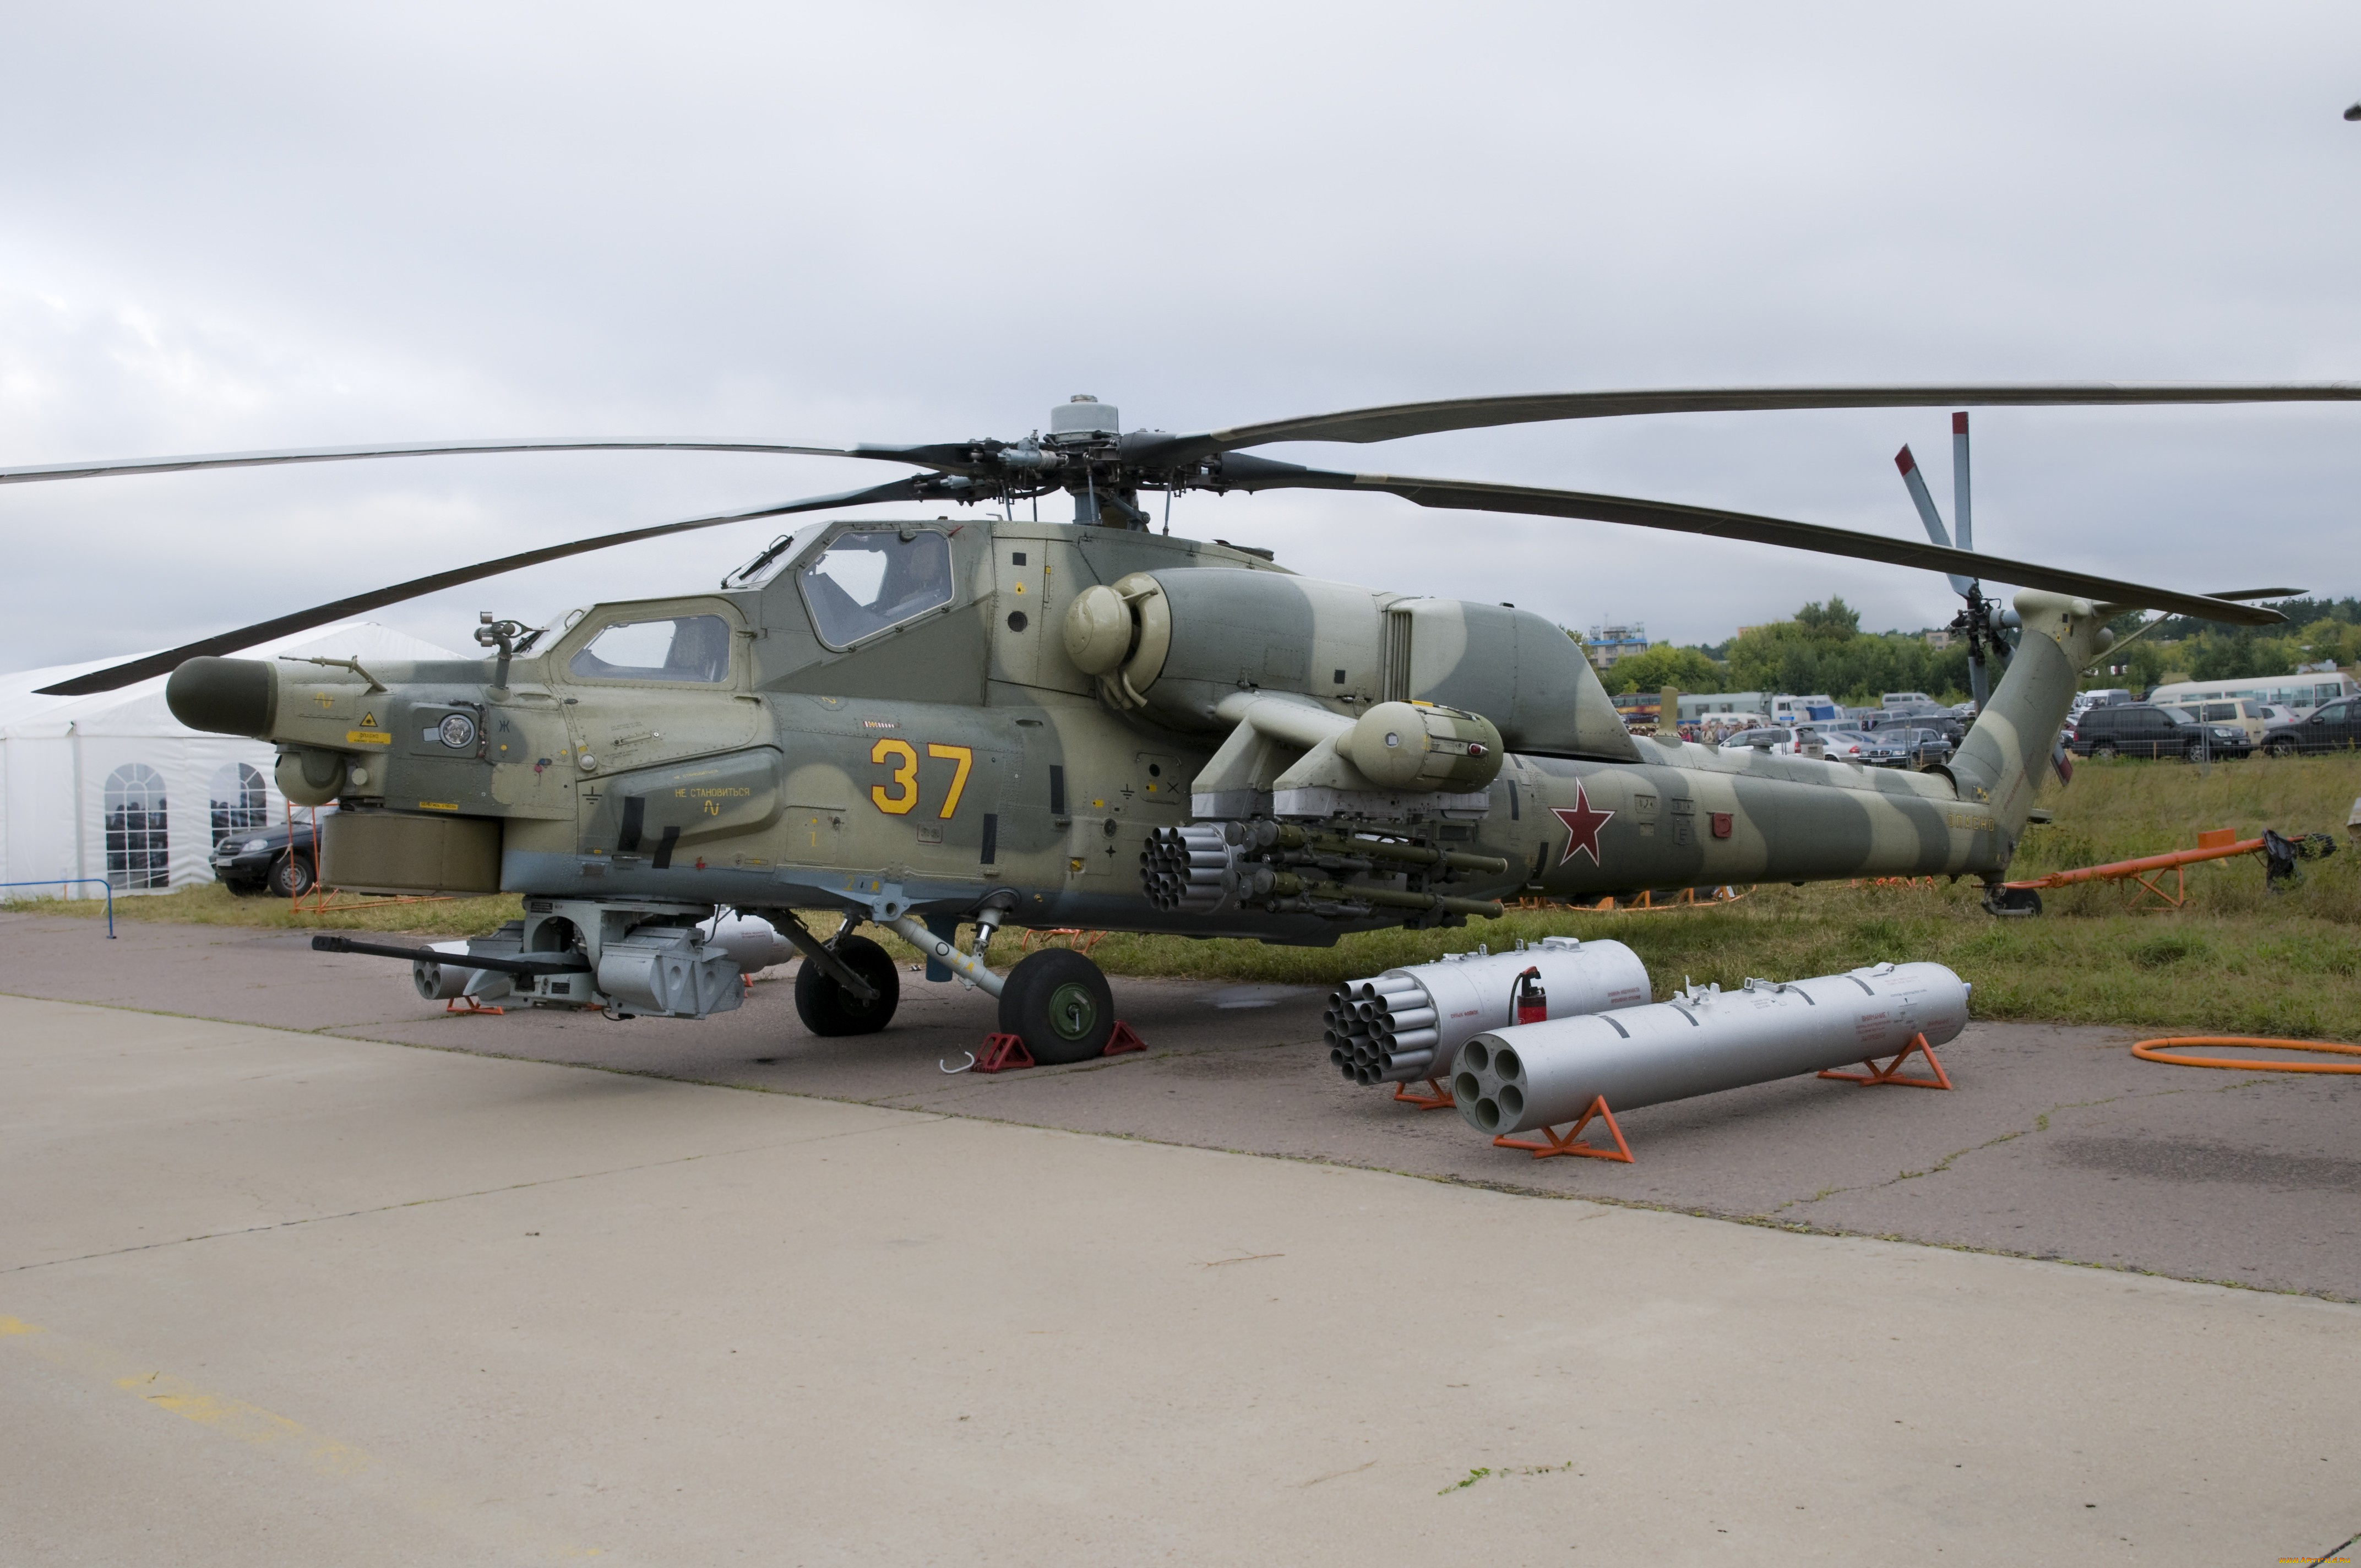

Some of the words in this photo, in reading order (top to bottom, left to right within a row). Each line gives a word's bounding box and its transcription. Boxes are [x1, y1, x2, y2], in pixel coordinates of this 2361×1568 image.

[871, 737, 973, 819] 37
[675, 788, 687, 798] НЕ
[690, 787, 750, 797] СТАНОВИТЬСЯ
[1947, 813, 1995, 832] ОПАСНО
